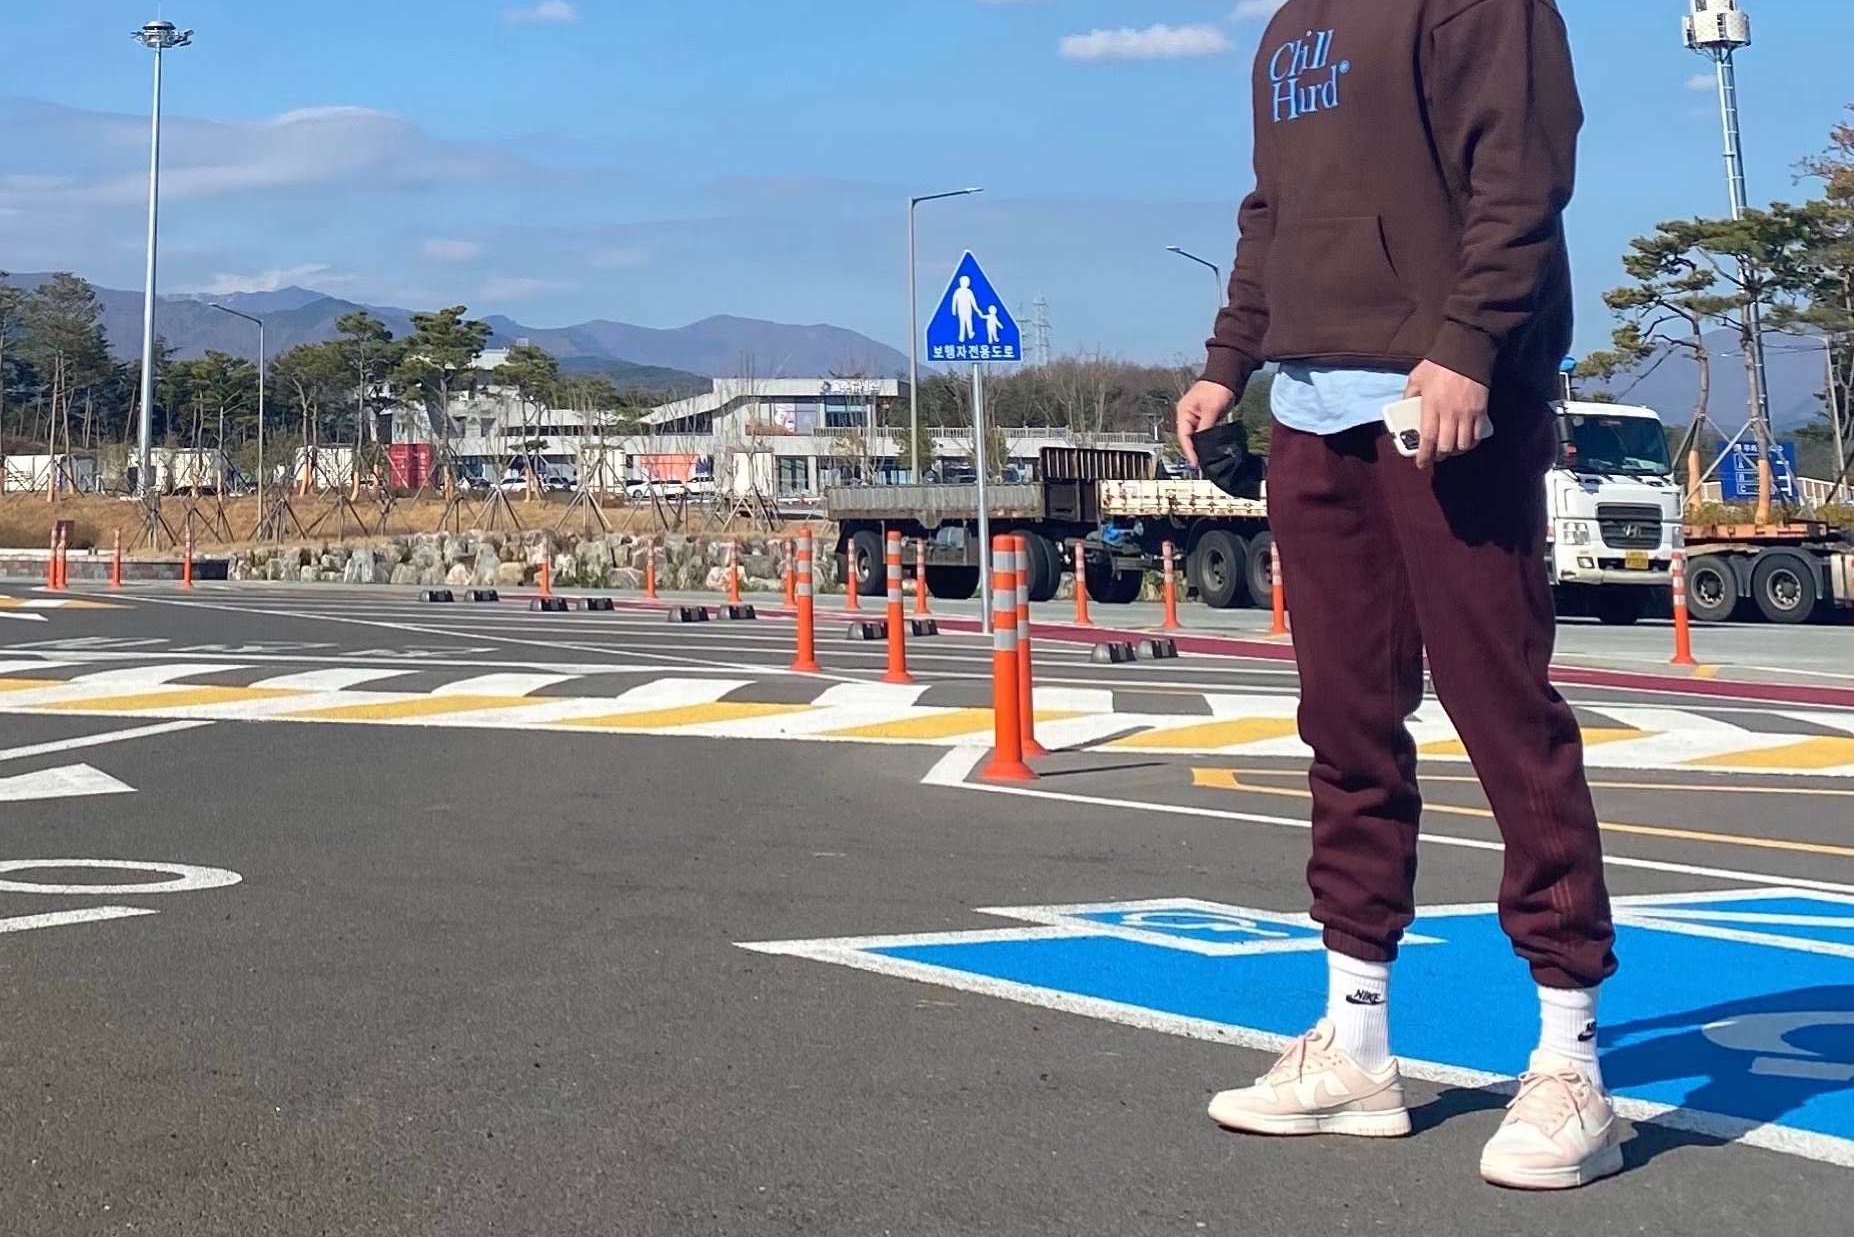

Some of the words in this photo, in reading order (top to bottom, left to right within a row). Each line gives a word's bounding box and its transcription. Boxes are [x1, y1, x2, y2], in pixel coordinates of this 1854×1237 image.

[1270, 29, 1335, 82] Chill
[933, 345, 1015, 359] 보행자전용도로
[1353, 989, 1381, 1004] NIKE
